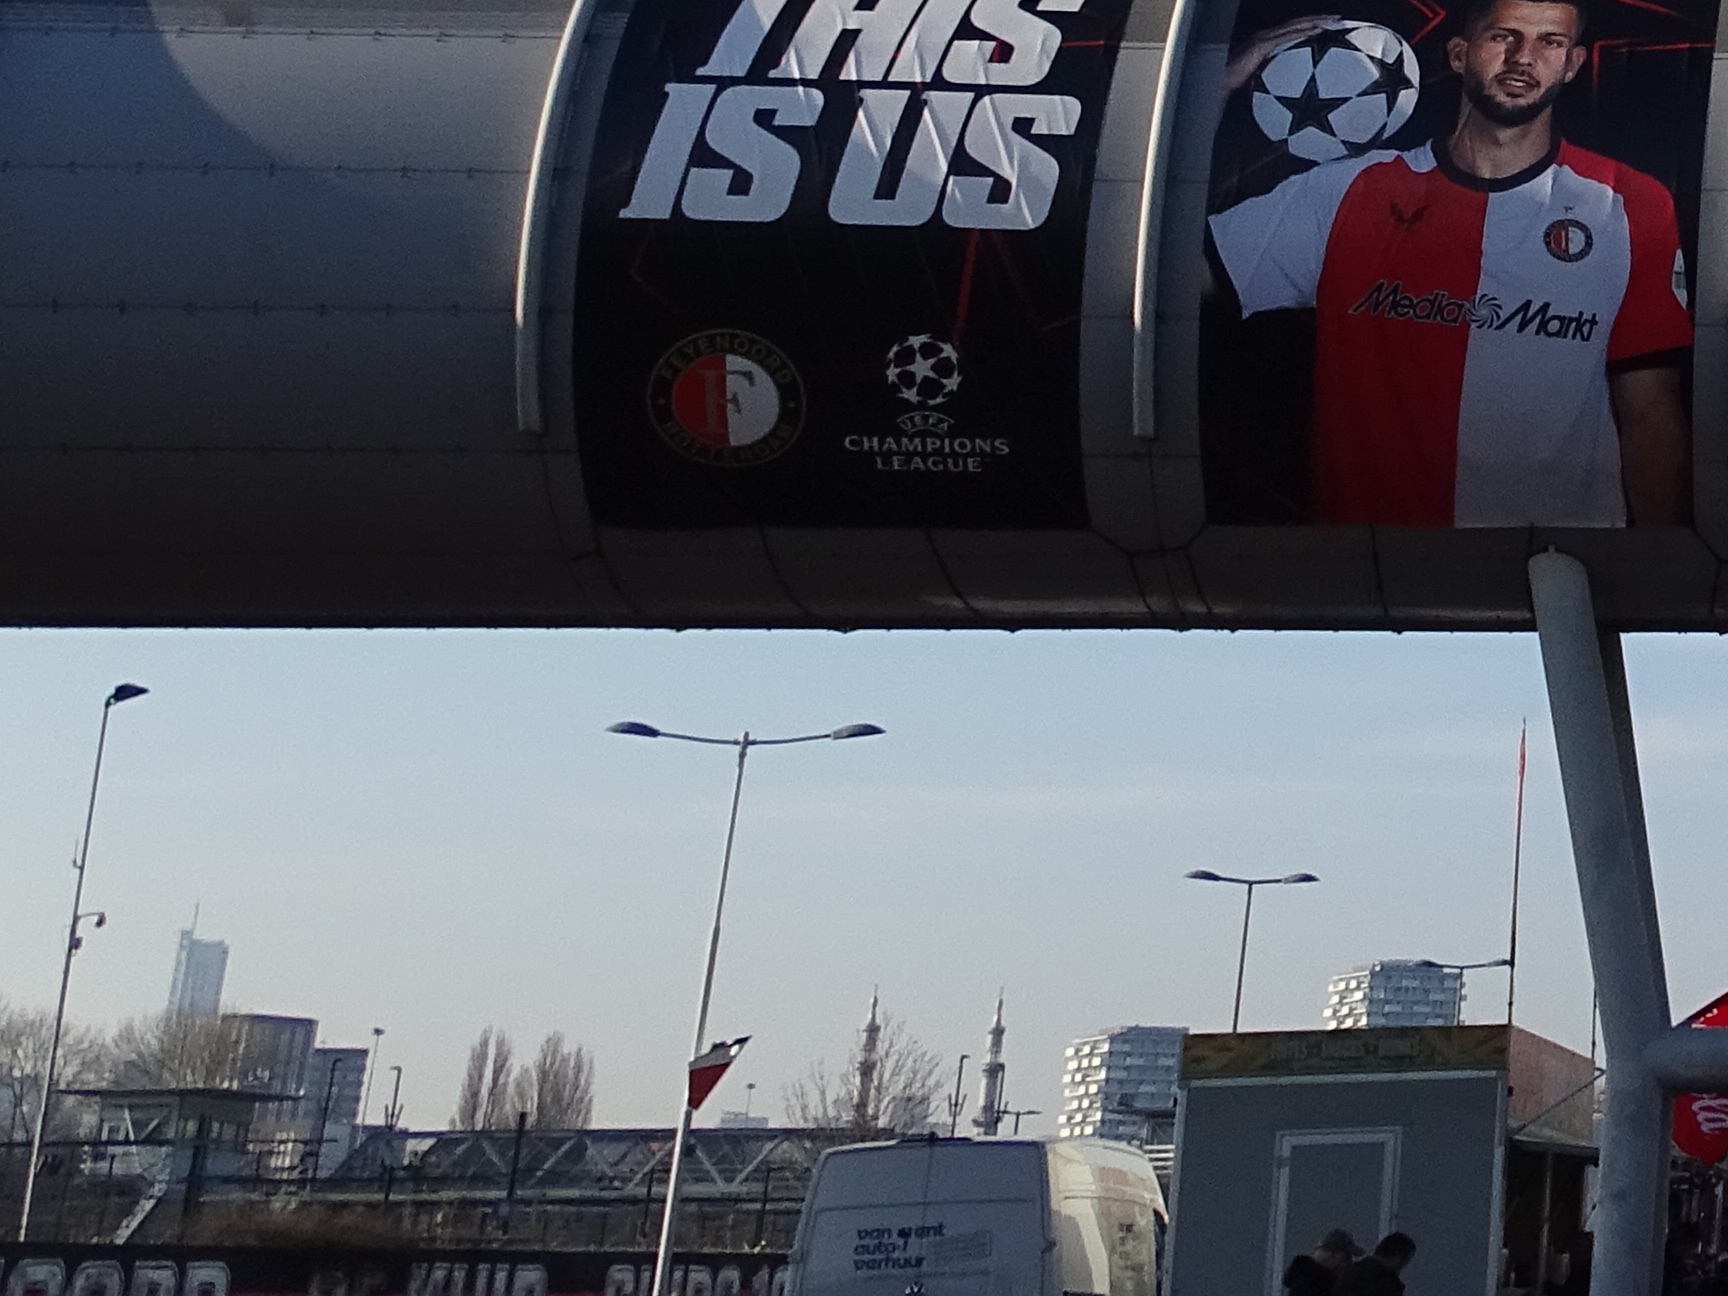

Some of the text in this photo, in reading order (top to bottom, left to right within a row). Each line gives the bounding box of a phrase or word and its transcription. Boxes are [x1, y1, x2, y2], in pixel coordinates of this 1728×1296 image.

[619, 83, 1082, 231] IS US
[1349, 278, 1599, 343] Media Markt
[661, 335, 794, 384] FEYENOORD
[898, 413, 952, 433] UEFA
[844, 434, 1010, 457] CHAMPIONS
[875, 456, 983, 473] LEAGUE
